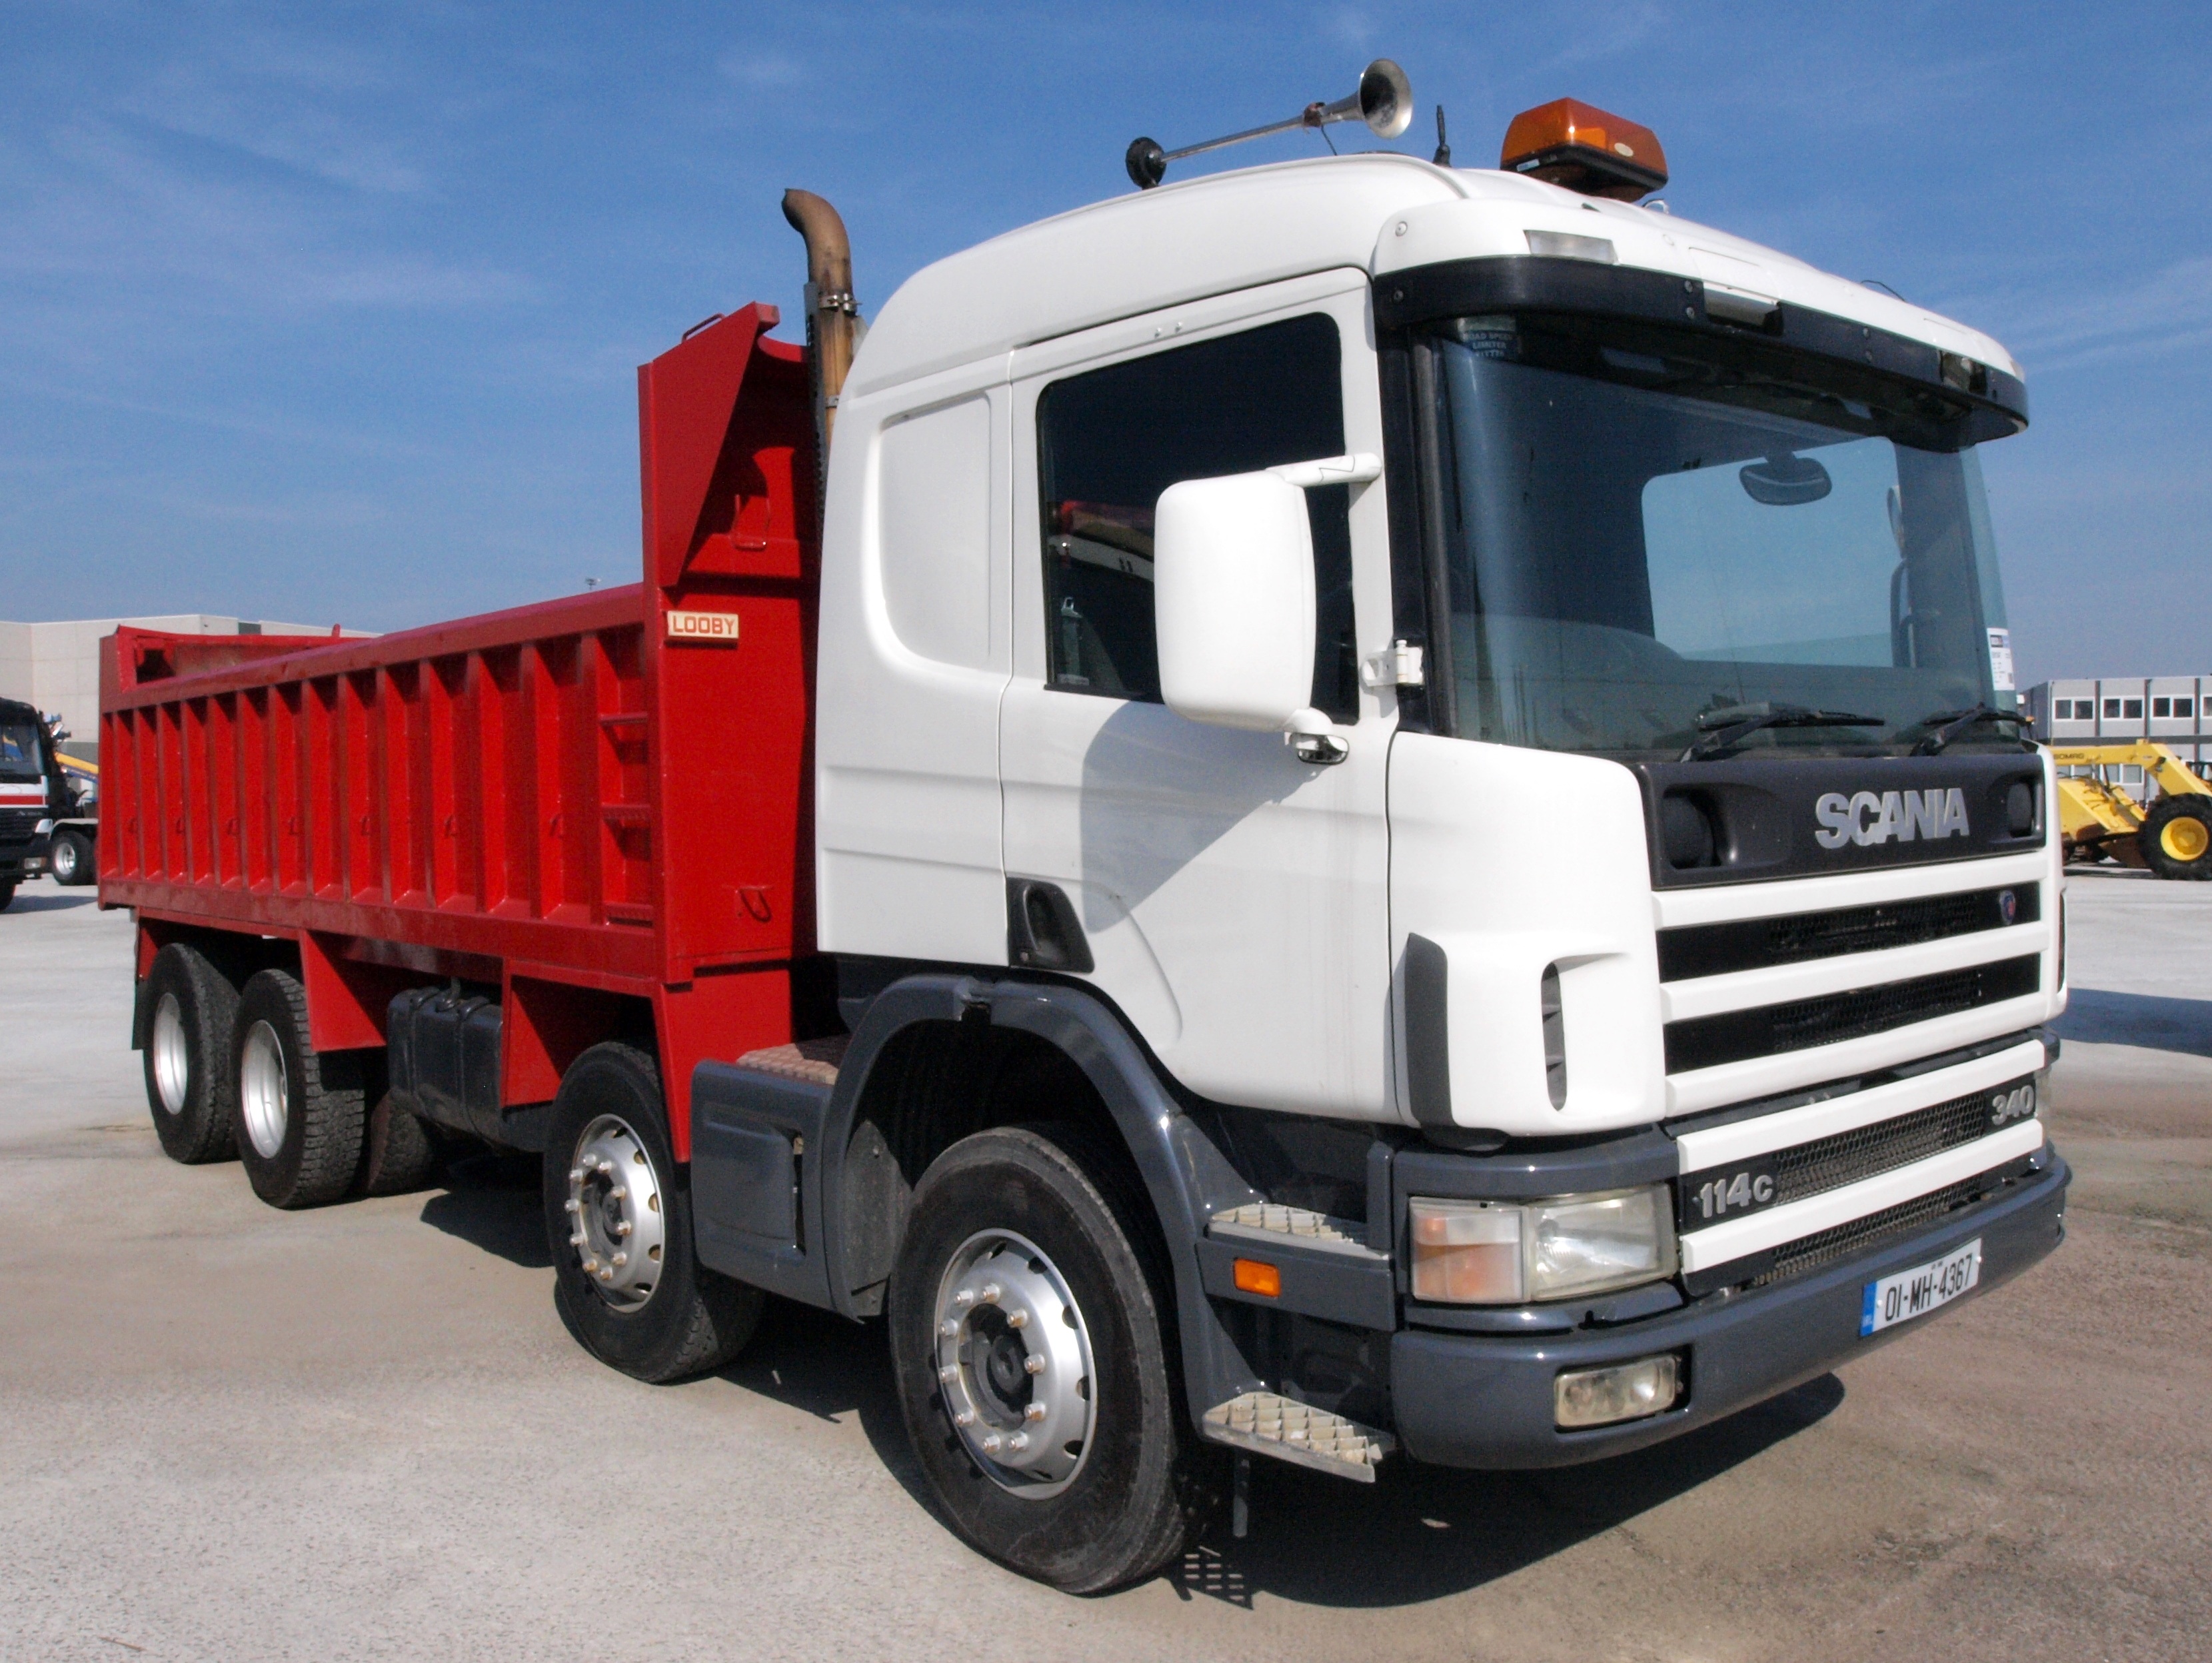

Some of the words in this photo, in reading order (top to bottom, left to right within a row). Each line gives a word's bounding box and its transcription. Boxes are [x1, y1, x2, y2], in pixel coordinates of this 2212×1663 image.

[673, 615, 735, 635] LOOBY
[1815, 788, 1969, 849] SCANIA
[1991, 1085, 2034, 1126] 340
[1885, 1253, 1973, 1321] 01-MH-4367
